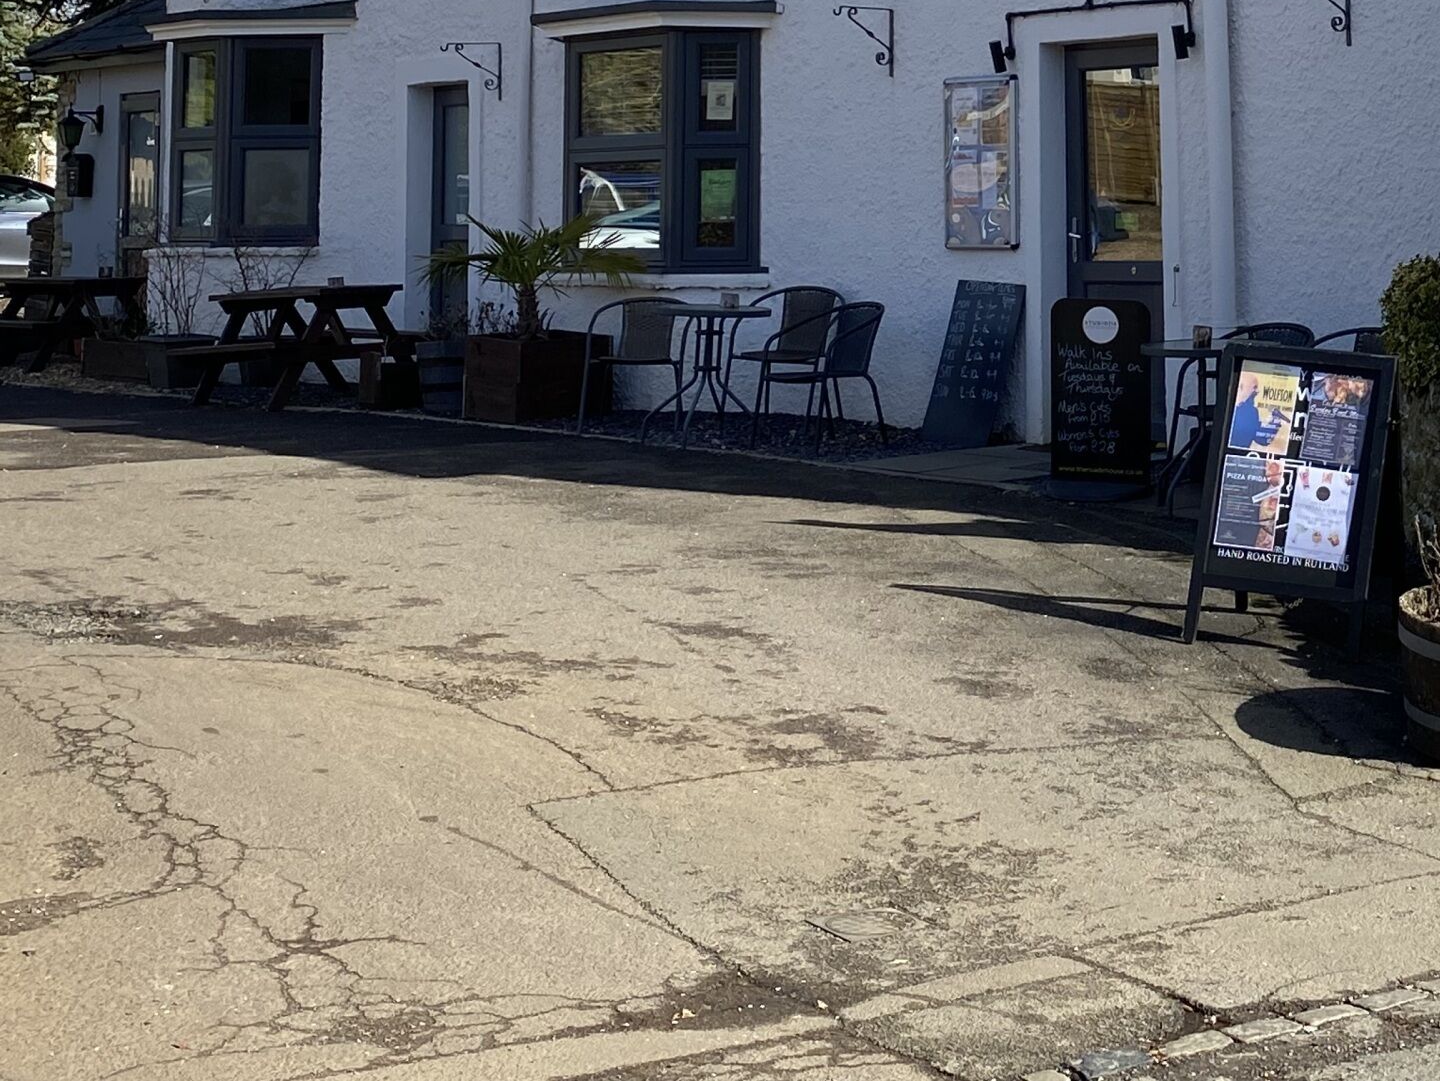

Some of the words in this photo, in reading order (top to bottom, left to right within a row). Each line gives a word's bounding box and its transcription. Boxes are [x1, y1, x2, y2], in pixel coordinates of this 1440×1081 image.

[1057, 342, 1087, 359] Walk
[1065, 358, 1121, 372] Available
[1217, 548, 1245, 559] HAND
[1246, 551, 1290, 565] ROASTED
[1292, 556, 1302, 566] IN
[1304, 558, 1350, 573] RUTLAND
